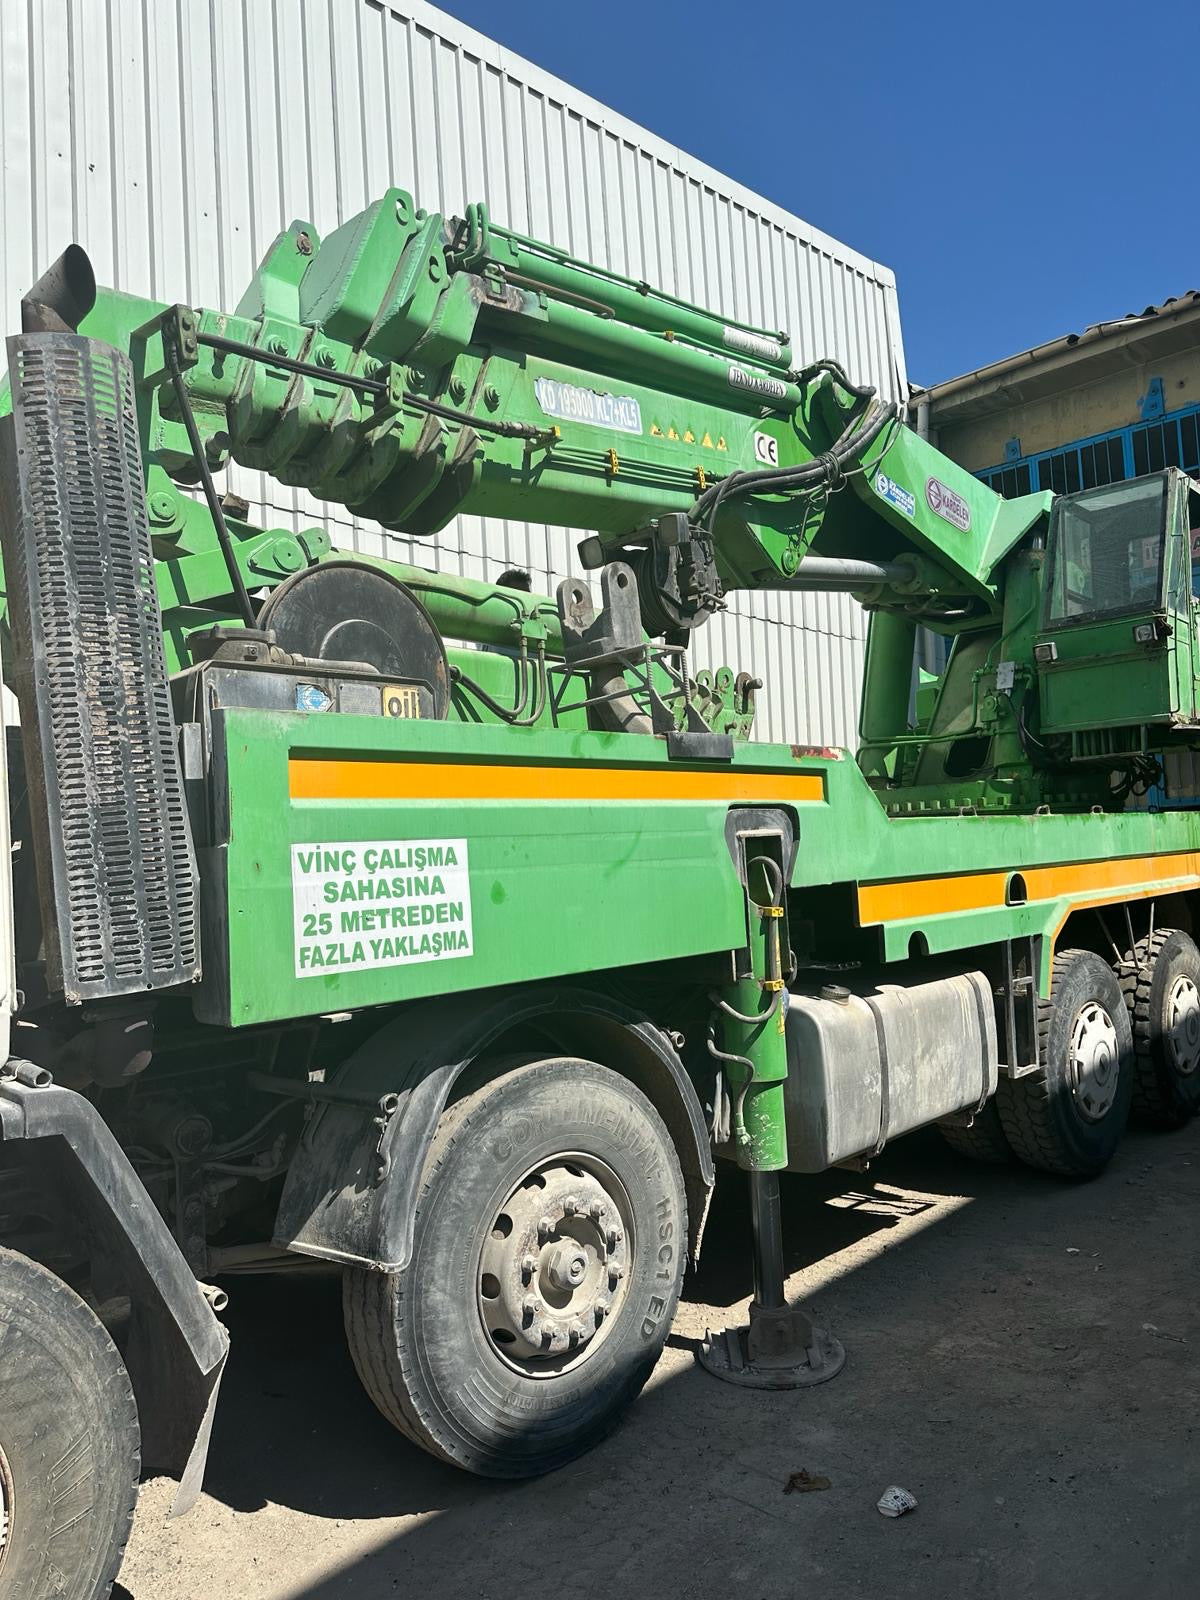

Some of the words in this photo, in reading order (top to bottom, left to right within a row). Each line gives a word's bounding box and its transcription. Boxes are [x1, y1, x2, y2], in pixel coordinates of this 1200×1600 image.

[539, 382, 556, 410] KD
[757, 436, 776, 463] CE
[942, 493, 969, 520] KARDELEN
[297, 845, 356, 875] VİNÇ
[363, 846, 458, 874] ÇALIŞMA
[323, 875, 446, 903] SAHASINA
[303, 913, 333, 937] 25
[340, 901, 464, 933] METREDEN
[299, 941, 366, 969] FAZLA
[369, 930, 469, 957] YAKLAŞMA
